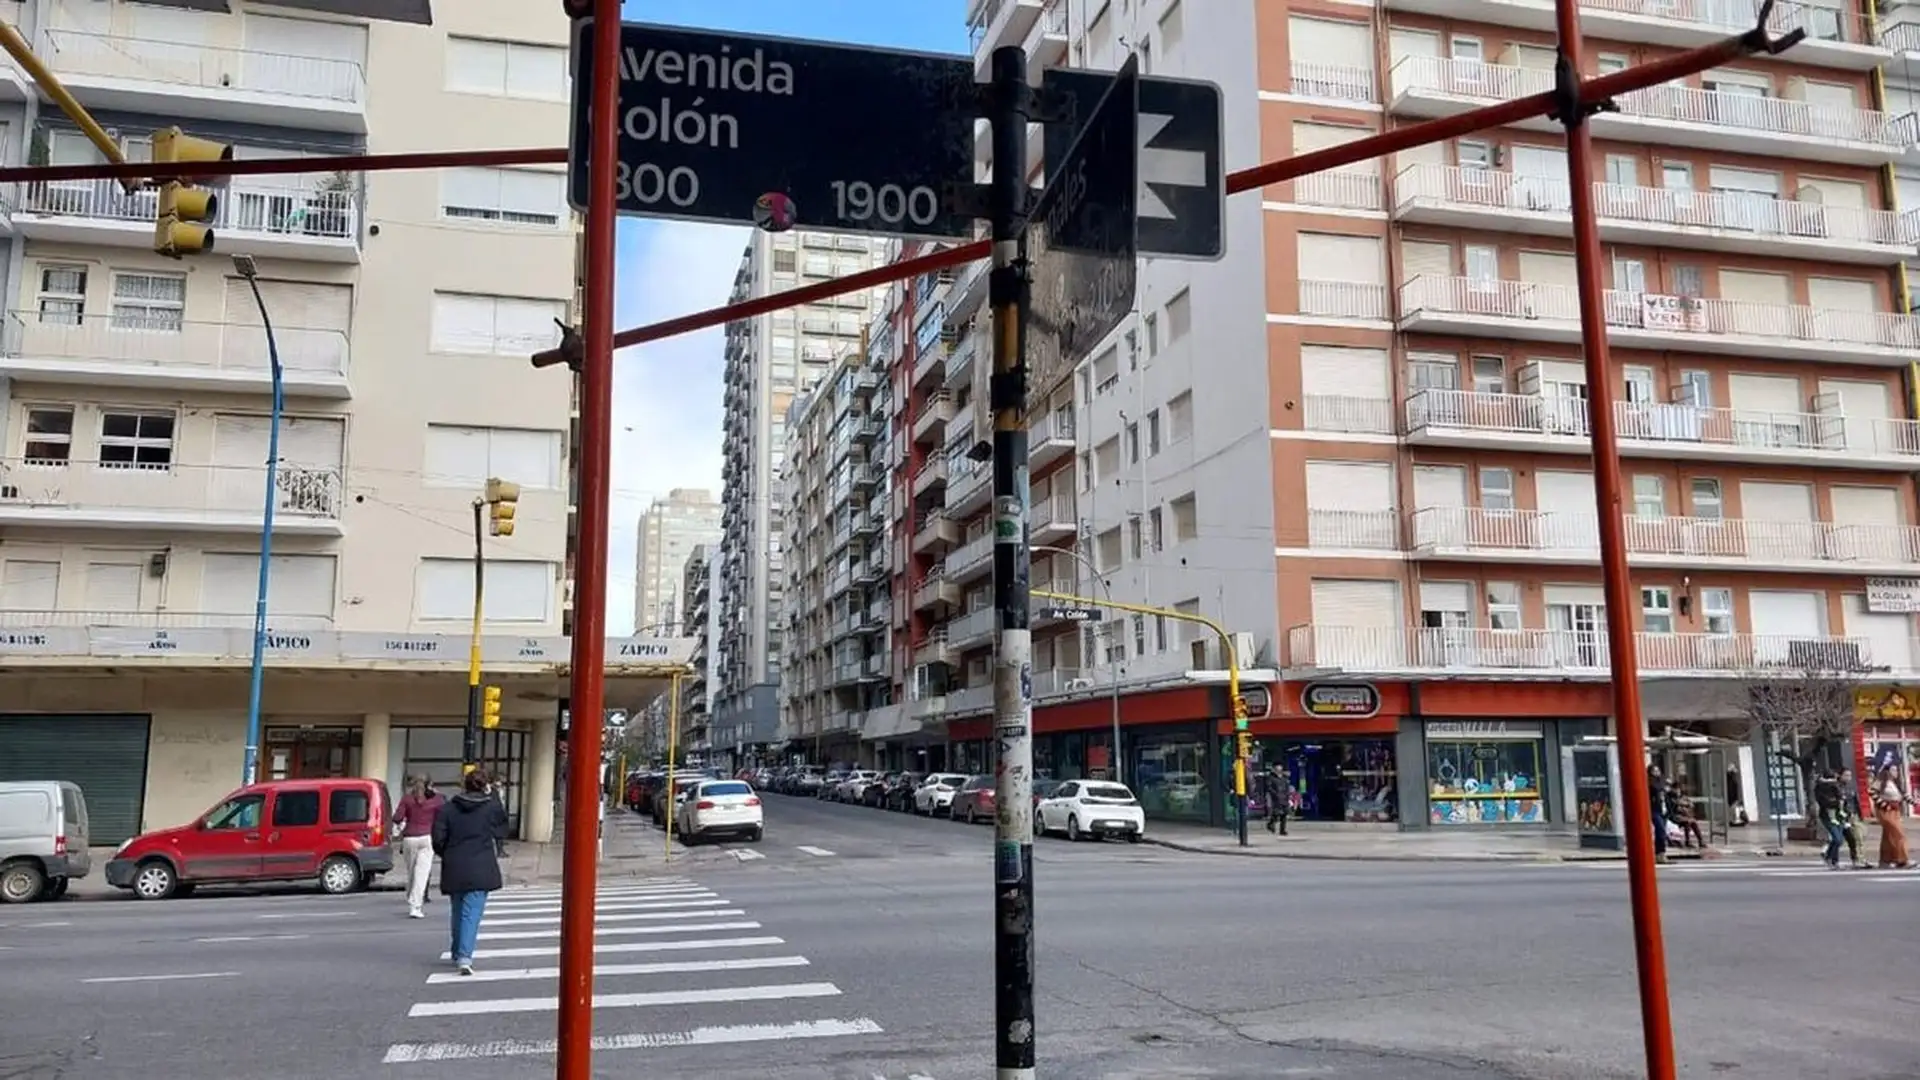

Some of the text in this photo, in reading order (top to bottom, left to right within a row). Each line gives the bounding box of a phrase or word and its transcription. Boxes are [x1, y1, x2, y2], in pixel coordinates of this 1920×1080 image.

[589, 96, 739, 149] olón
[831, 179, 938, 226] 1900
[264, 636, 310, 649] APICO
[620, 643, 668, 656] ZAPICO
